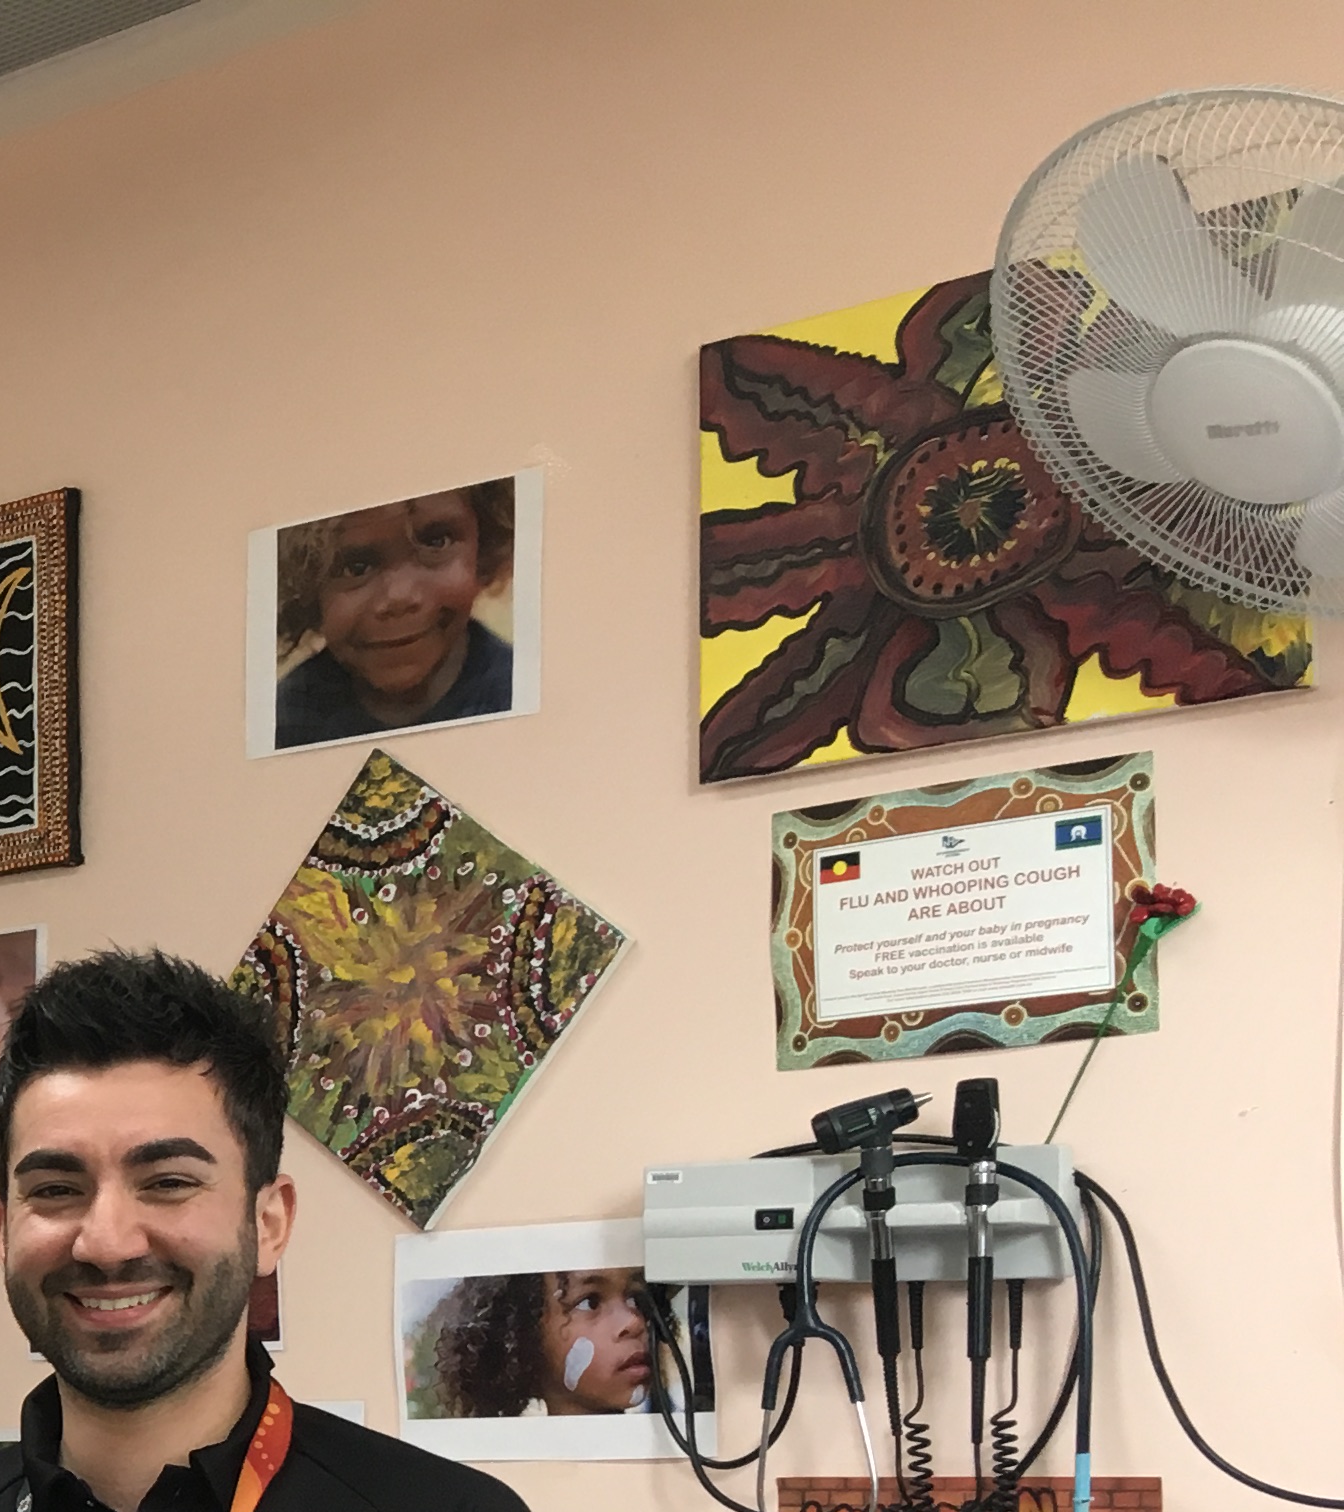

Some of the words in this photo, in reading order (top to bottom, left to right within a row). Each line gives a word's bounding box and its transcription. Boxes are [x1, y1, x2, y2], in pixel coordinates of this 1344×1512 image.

[911, 862, 963, 881] WATCH
[968, 856, 1001, 872] OUT
[839, 894, 869, 911] FLU
[873, 889, 909, 906] AND
[912, 874, 1009, 900] WHOOPING
[1014, 865, 1081, 886] COUGH
[907, 905, 942, 921] ARE
[946, 896, 1007, 917] ABOUT
[834, 940, 874, 955] Protect
[876, 933, 922, 952] yourself
[925, 931, 946, 944] and
[948, 930, 975, 944] your
[978, 923, 1007, 940] baby
[1011, 921, 1021, 932] in
[1024, 914, 1090, 934] pregnancy
[875, 950, 906, 963] FREE
[908, 941, 975, 958] vaccination
[978, 938, 988, 949] is
[991, 932, 1044, 947] available
[849, 966, 884, 981] Speak
[886, 964, 898, 975] to
[900, 961, 926, 976] your
[928, 955, 969, 970] doctor,
[972, 952, 1006, 964] nurse
[1009, 950, 1022, 960] or
[1025, 942, 1073, 958] midwife
